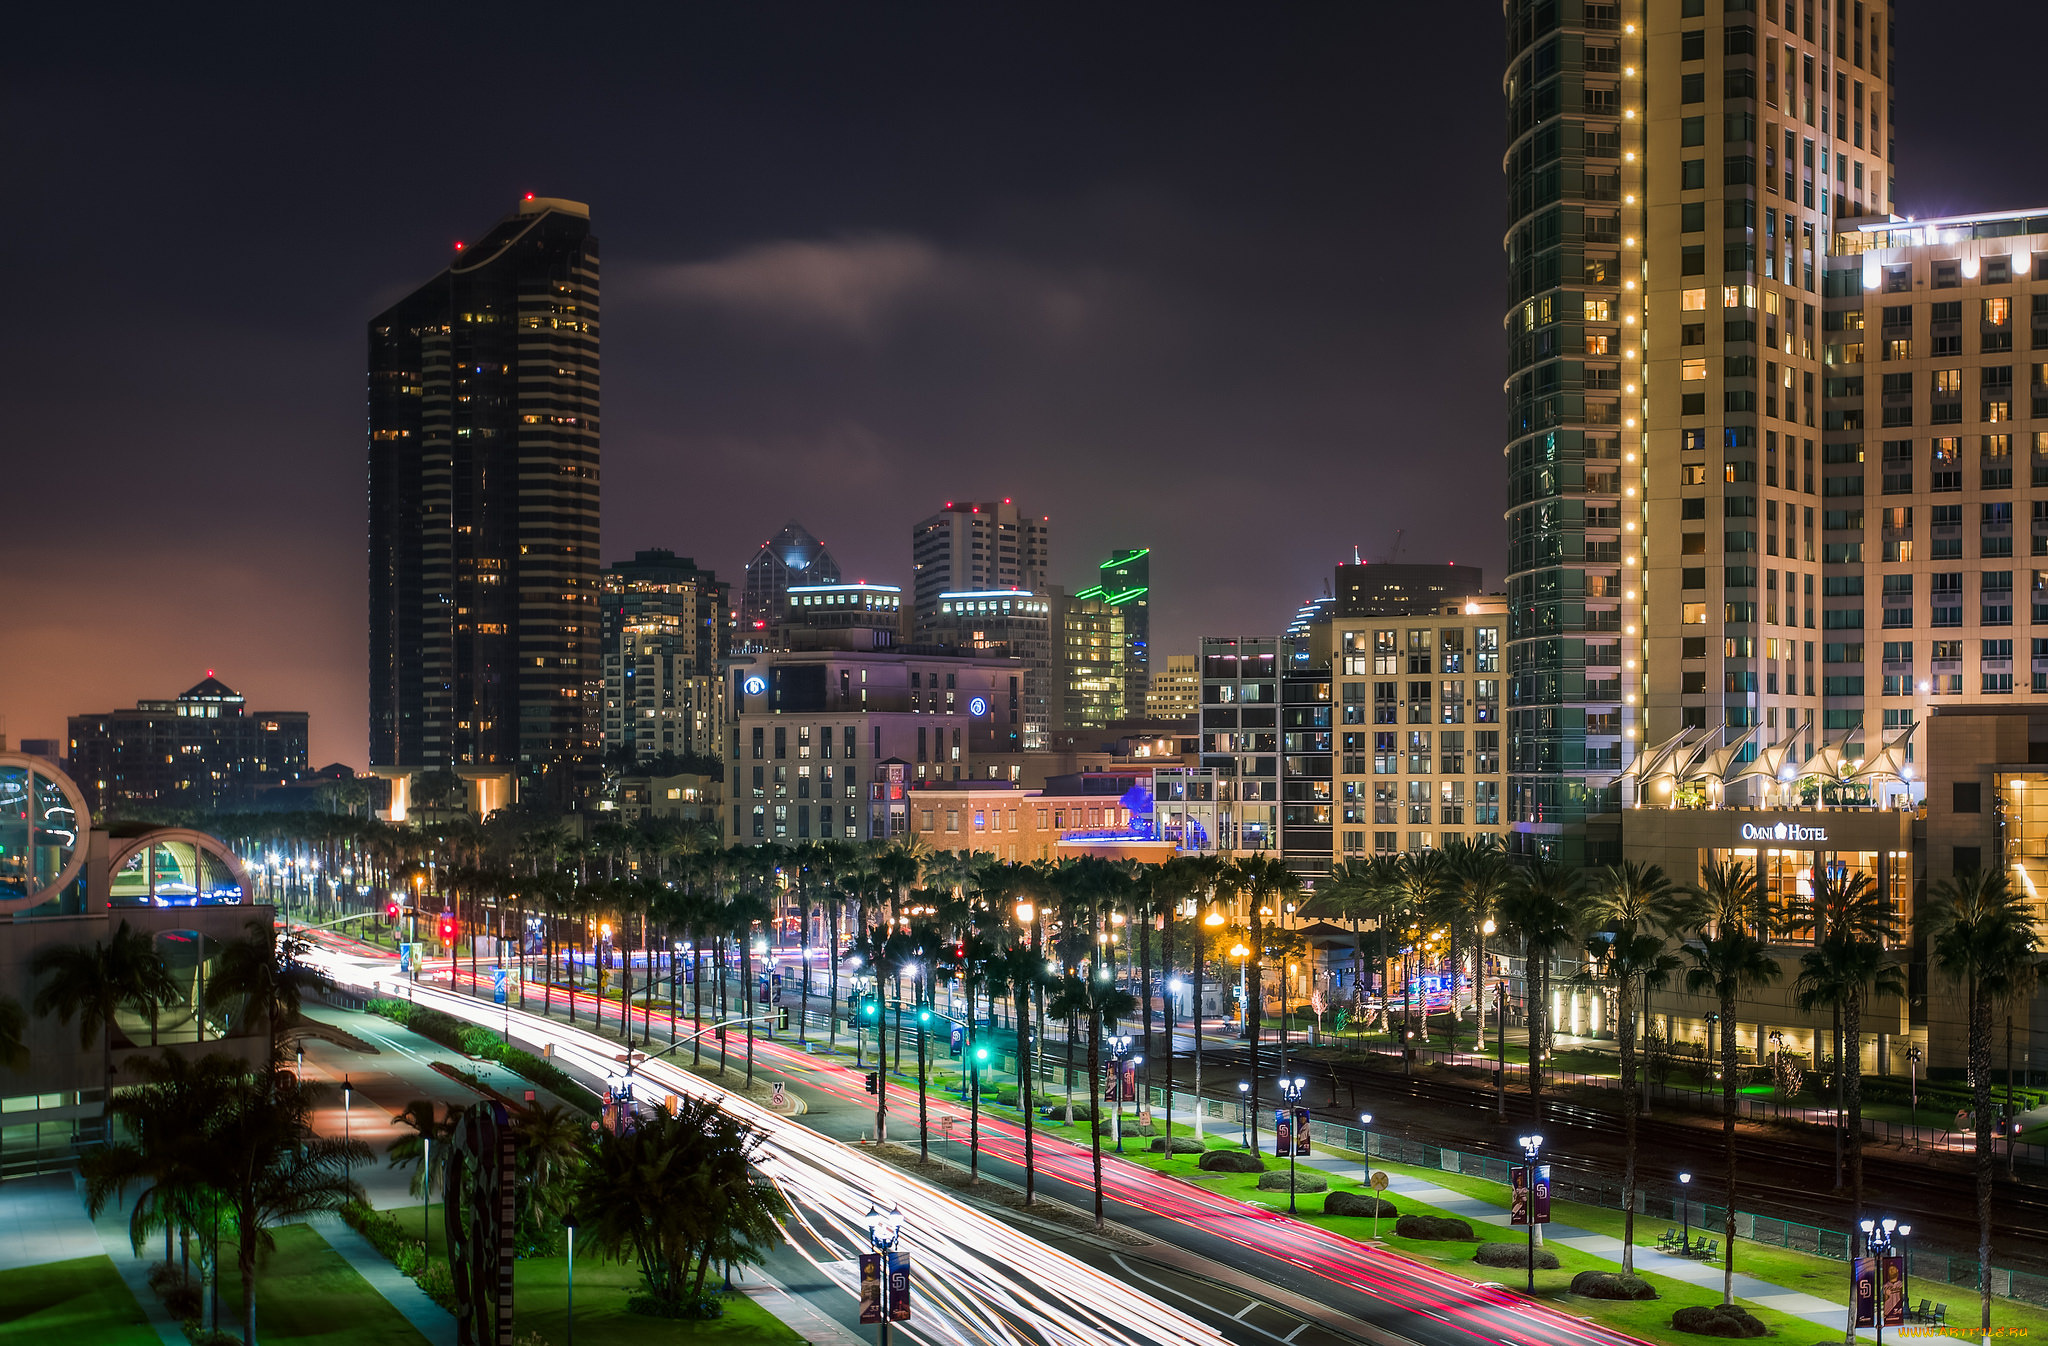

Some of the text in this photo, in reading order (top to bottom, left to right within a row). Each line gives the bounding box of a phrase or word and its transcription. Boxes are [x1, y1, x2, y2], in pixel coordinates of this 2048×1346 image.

[1788, 823, 1828, 841] HOTEL
[1536, 1183, 1547, 1199] SD
[892, 1273, 906, 1291] SD
[1860, 1279, 1872, 1299] SD
